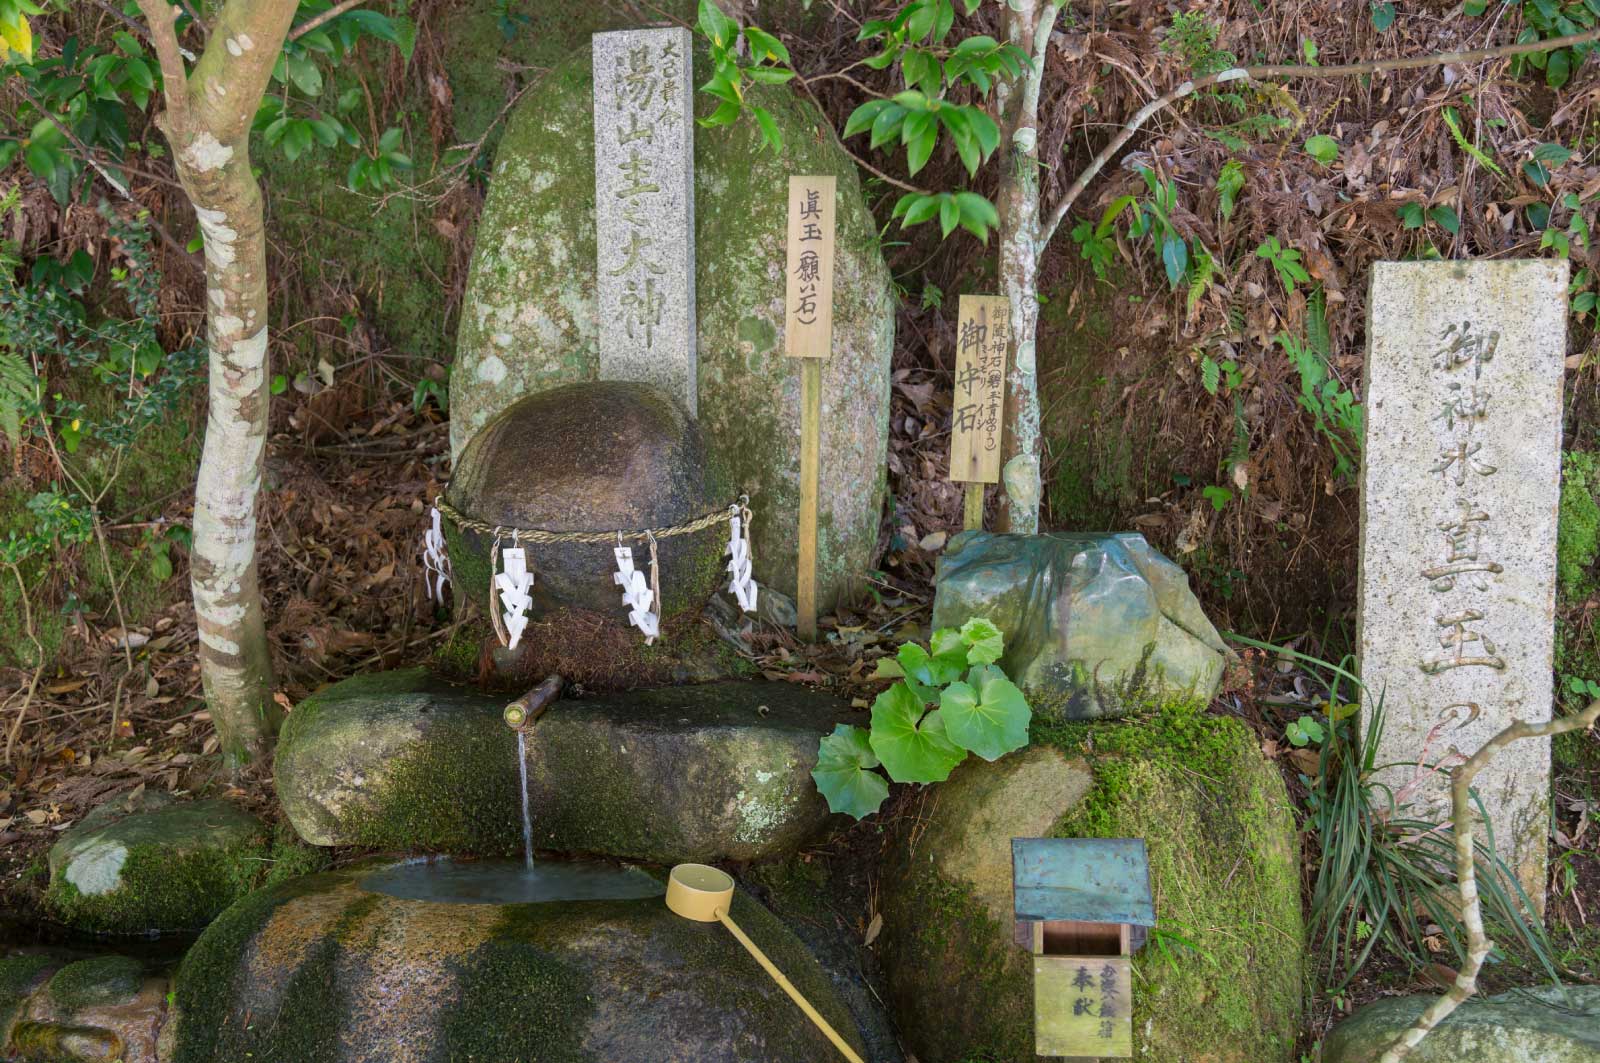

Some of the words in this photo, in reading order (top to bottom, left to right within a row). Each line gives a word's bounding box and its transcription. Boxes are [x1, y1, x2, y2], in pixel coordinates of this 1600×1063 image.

[657, 39, 681, 131] 大己貴命
[954, 317, 987, 434] 御守石
